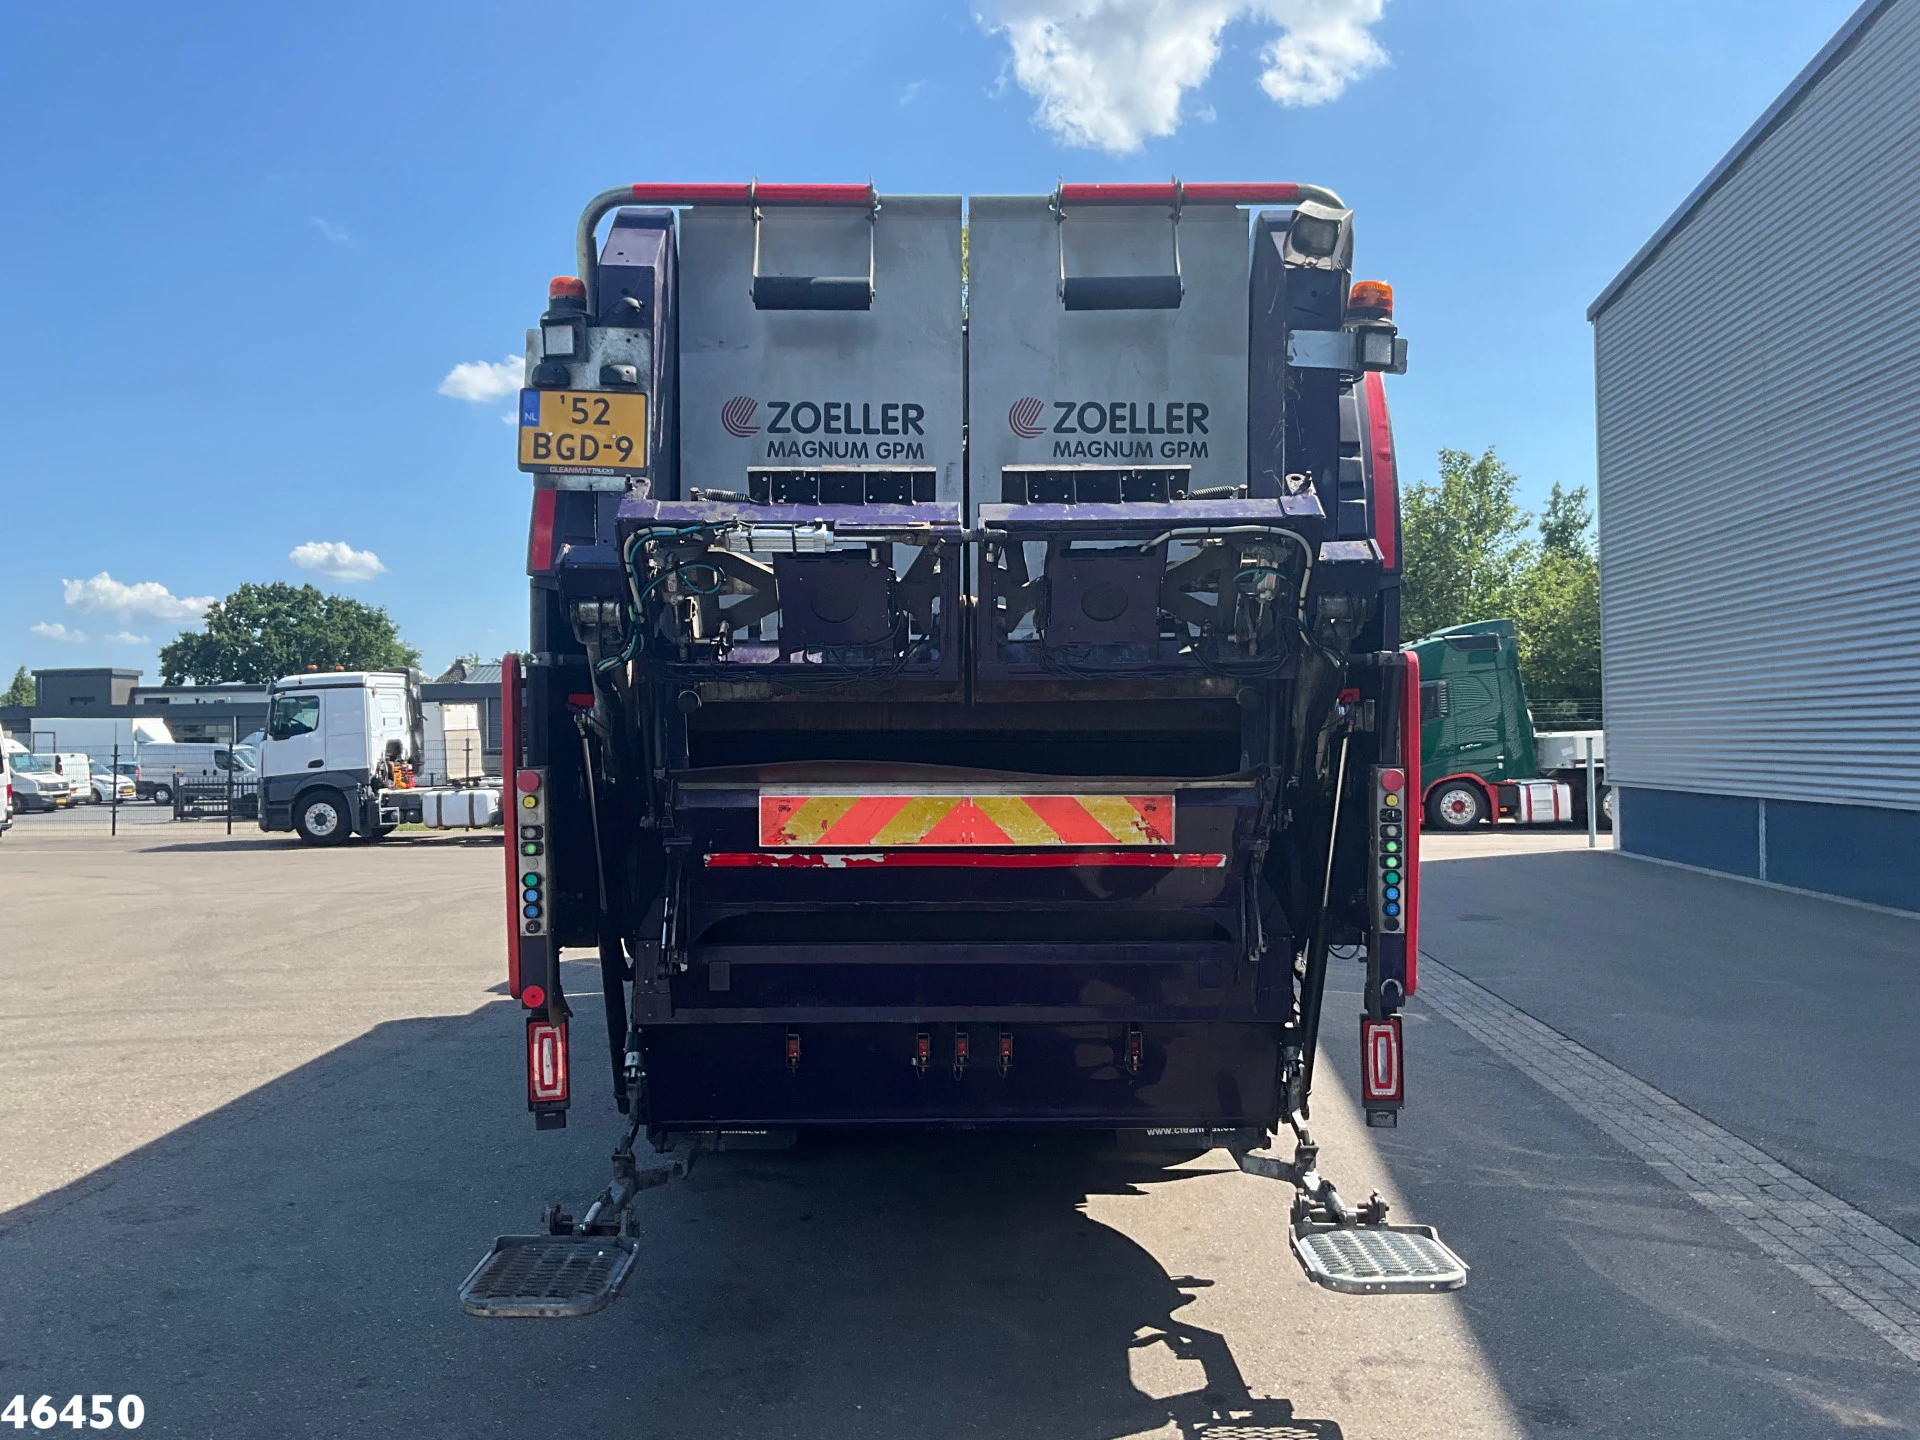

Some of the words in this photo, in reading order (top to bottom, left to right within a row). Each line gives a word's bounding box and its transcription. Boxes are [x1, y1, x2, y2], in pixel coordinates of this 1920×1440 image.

[524, 412, 537, 422] NL
[767, 401, 925, 436] ZOELLER
[1053, 401, 1209, 434] ZOELLER
[533, 432, 634, 463] BGD-9
[767, 440, 869, 459] MAGNUM
[876, 442, 925, 460] GPM
[1052, 440, 1154, 459] MAGNUM
[1160, 441, 1209, 459] GPM
